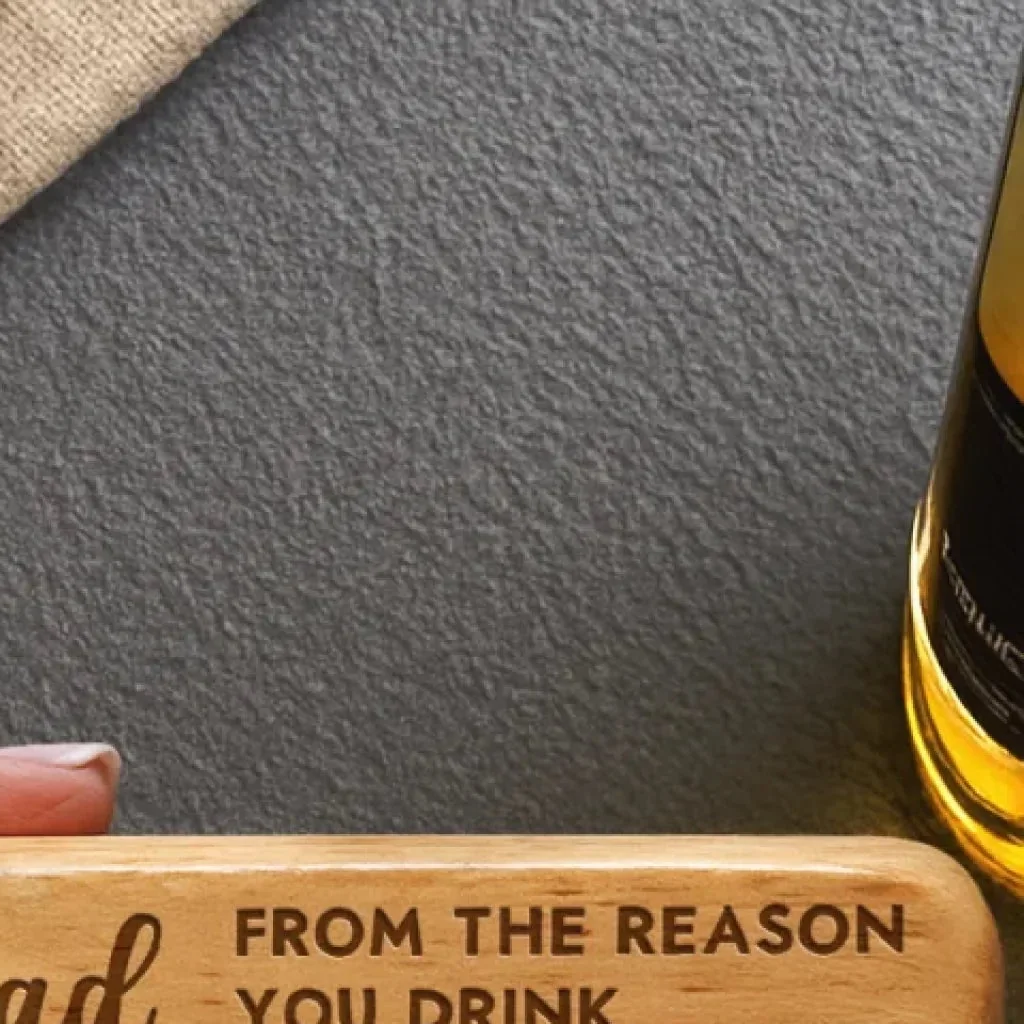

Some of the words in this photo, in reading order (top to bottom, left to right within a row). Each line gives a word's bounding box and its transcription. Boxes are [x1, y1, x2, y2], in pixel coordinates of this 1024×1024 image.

[236, 905, 423, 958] FROM
[453, 904, 592, 957] THE
[616, 901, 908, 956] REASON
